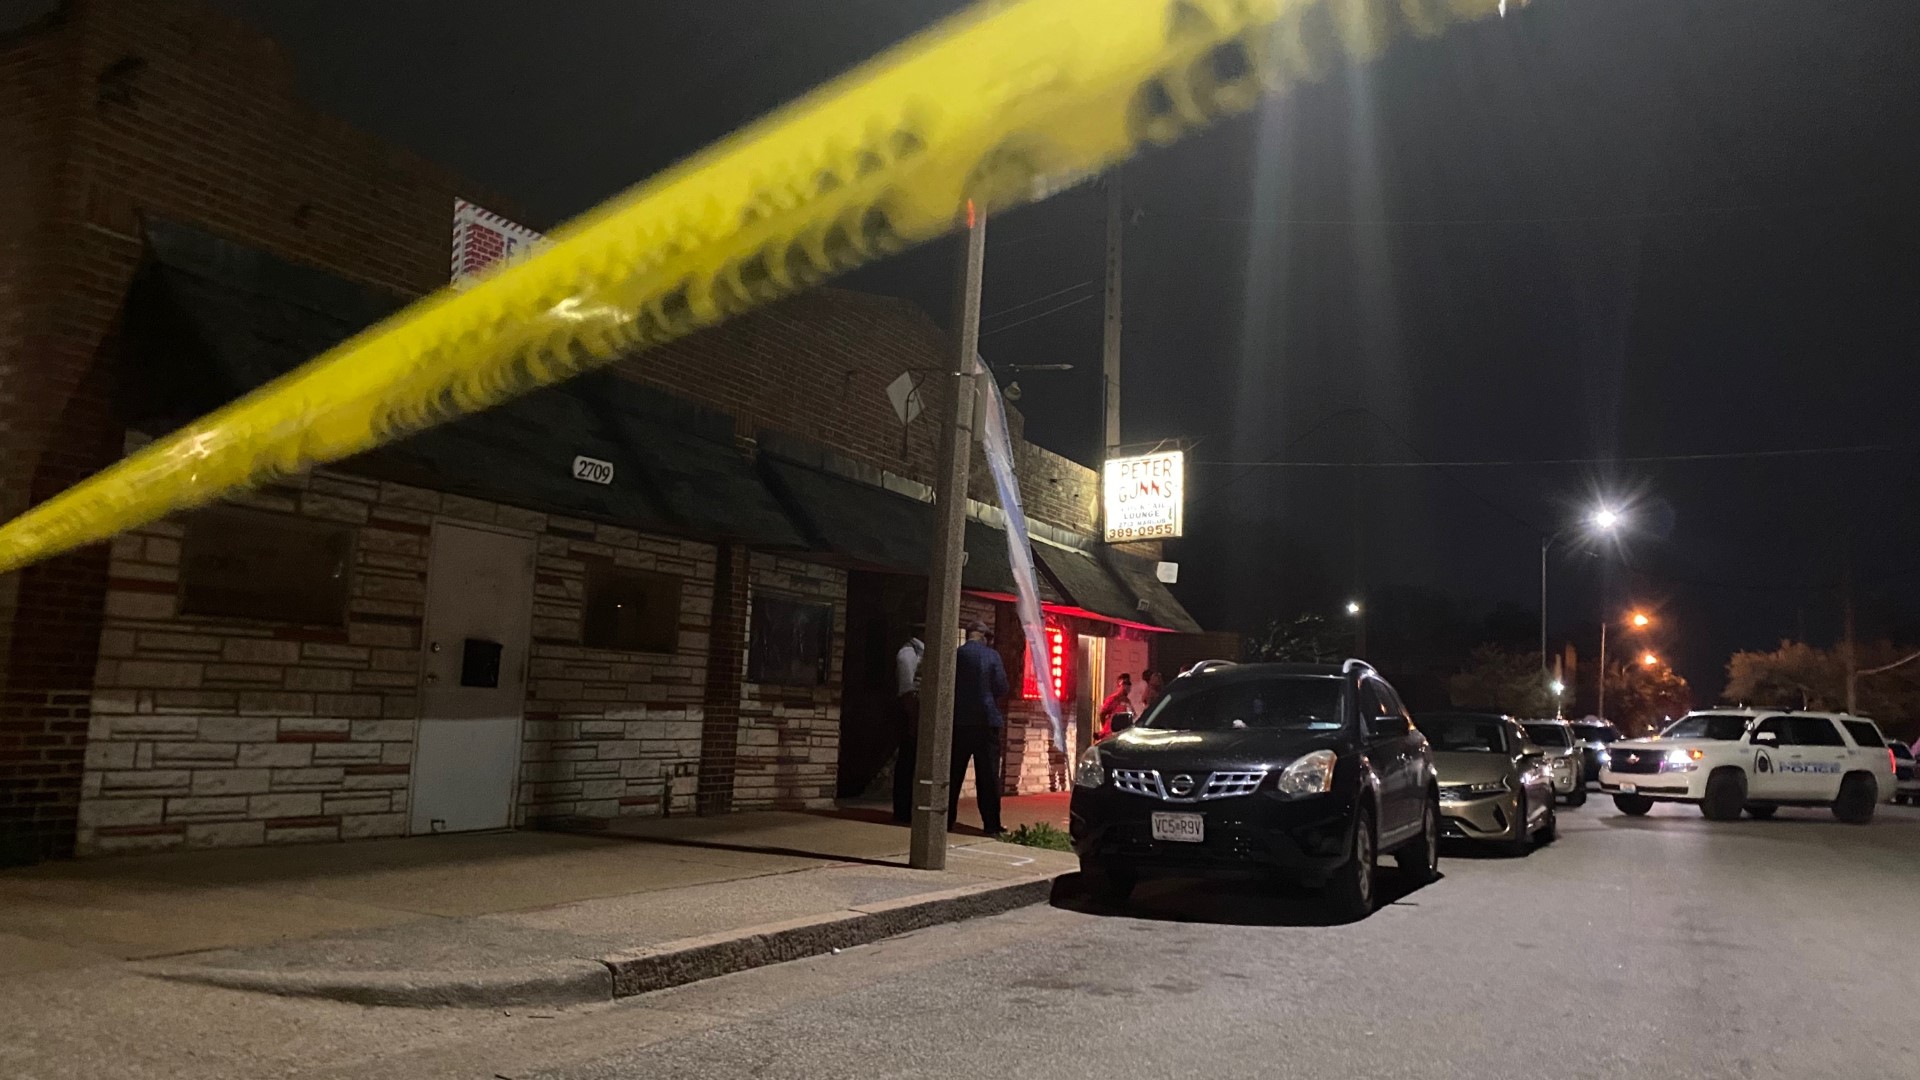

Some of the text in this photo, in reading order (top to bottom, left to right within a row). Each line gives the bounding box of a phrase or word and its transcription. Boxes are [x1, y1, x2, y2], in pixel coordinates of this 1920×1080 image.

[577, 460, 611, 482] 2709
[1121, 458, 1172, 479] PETER
[1123, 510, 1161, 520] LOUNGE
[1779, 764, 1842, 774] POLICE
